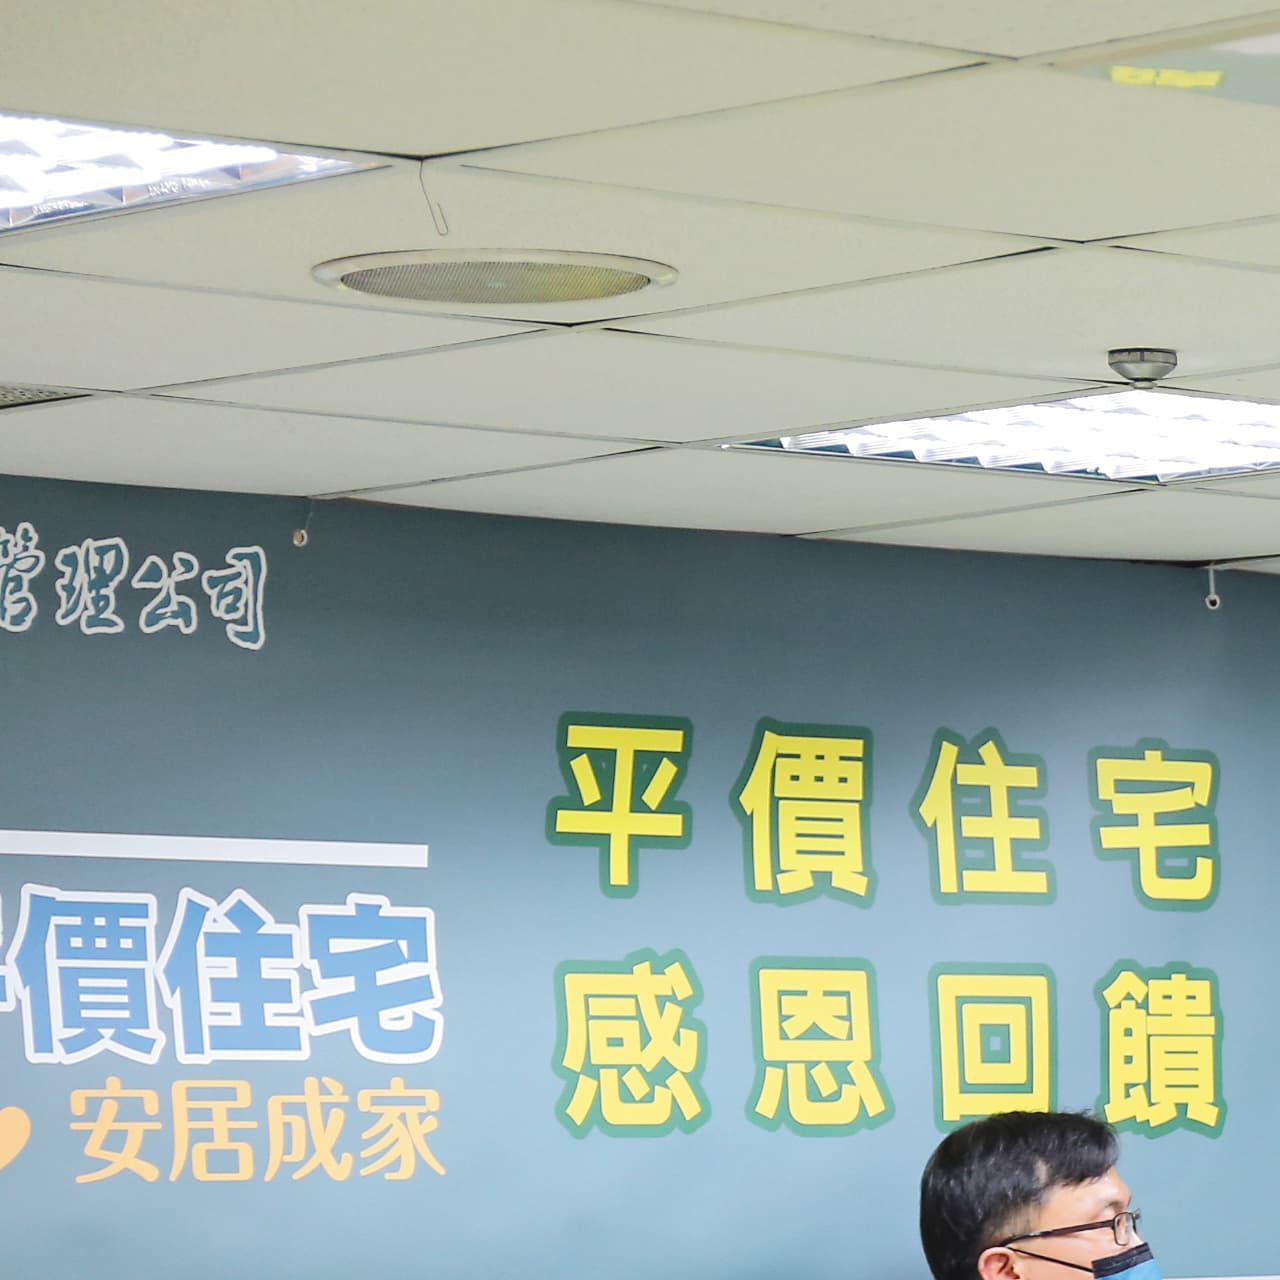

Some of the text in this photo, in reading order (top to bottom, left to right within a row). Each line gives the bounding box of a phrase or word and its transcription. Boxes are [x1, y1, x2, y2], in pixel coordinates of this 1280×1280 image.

[550, 718, 1217, 905] 平價住宅
[0, 884, 443, 1064] 價住宅
[557, 955, 1222, 1132] 感恩回饋
[69, 1076, 446, 1183] 安居成家
